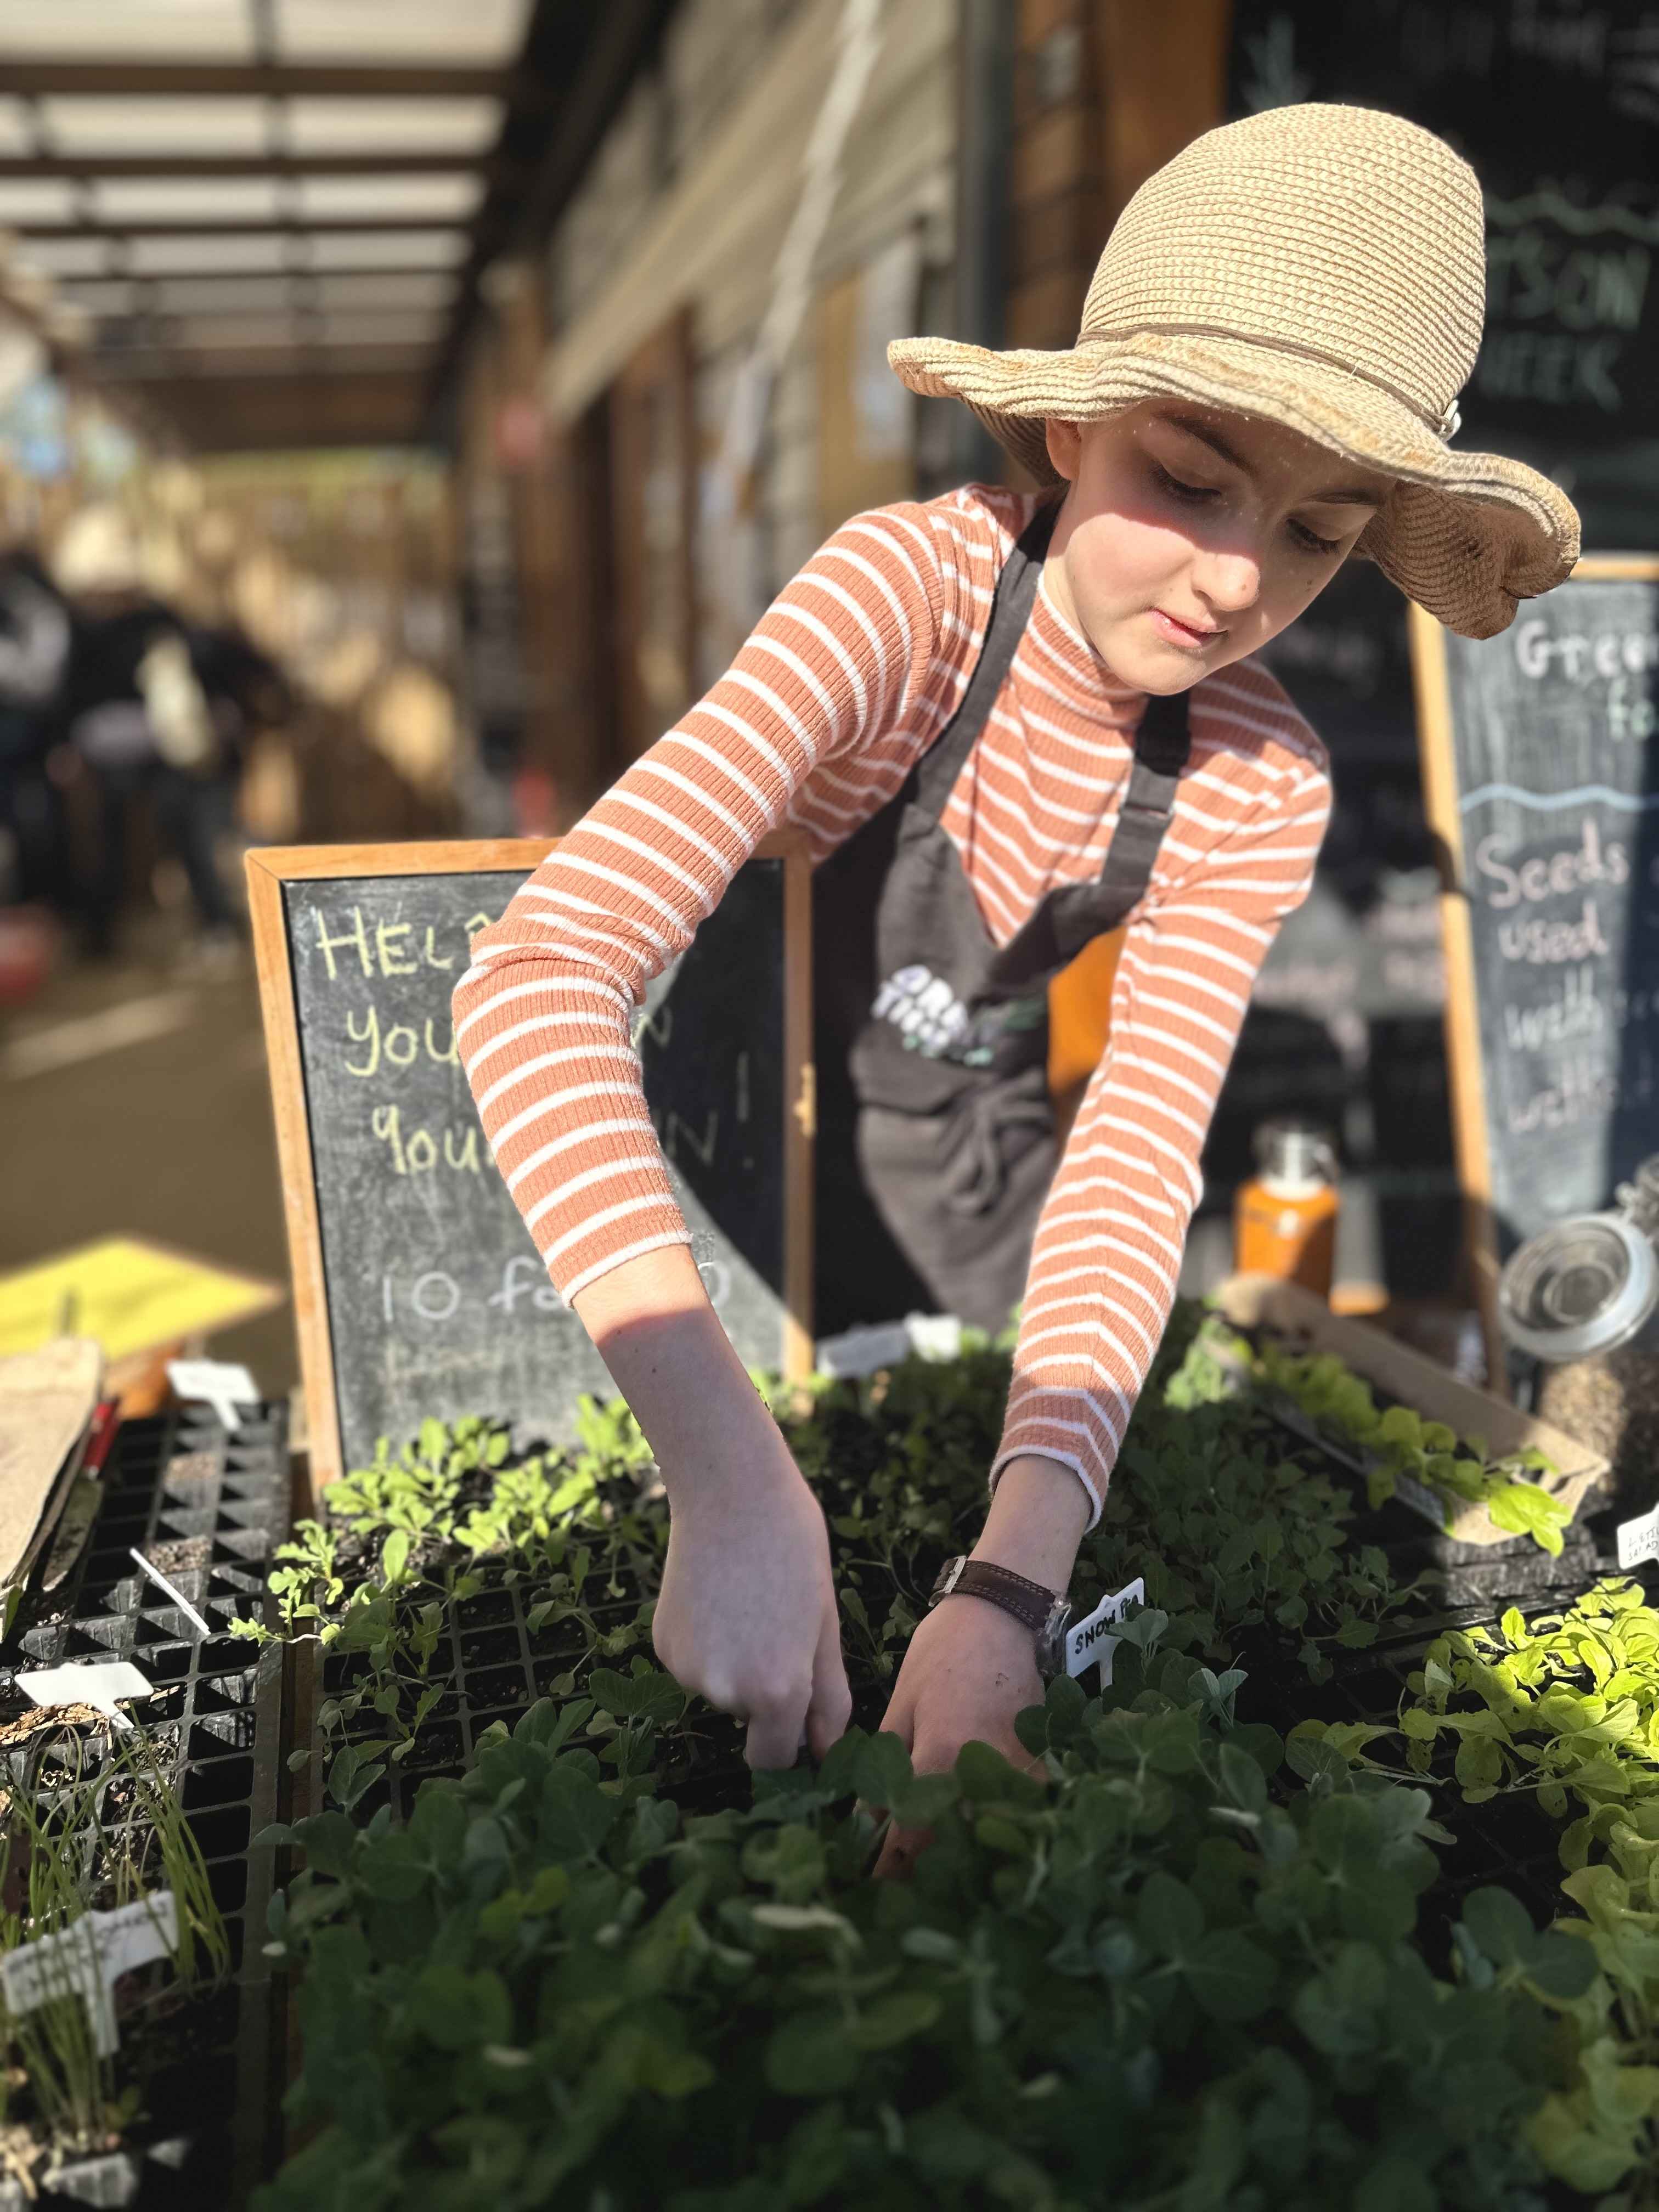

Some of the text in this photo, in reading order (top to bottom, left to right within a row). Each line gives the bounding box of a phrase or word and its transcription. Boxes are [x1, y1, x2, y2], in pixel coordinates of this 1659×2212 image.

[1476, 817, 1629, 909] Seeds
[373, 1103, 495, 1174] you
[383, 1270, 460, 1322] 10
[1075, 1609, 1115, 1655] SNOW
